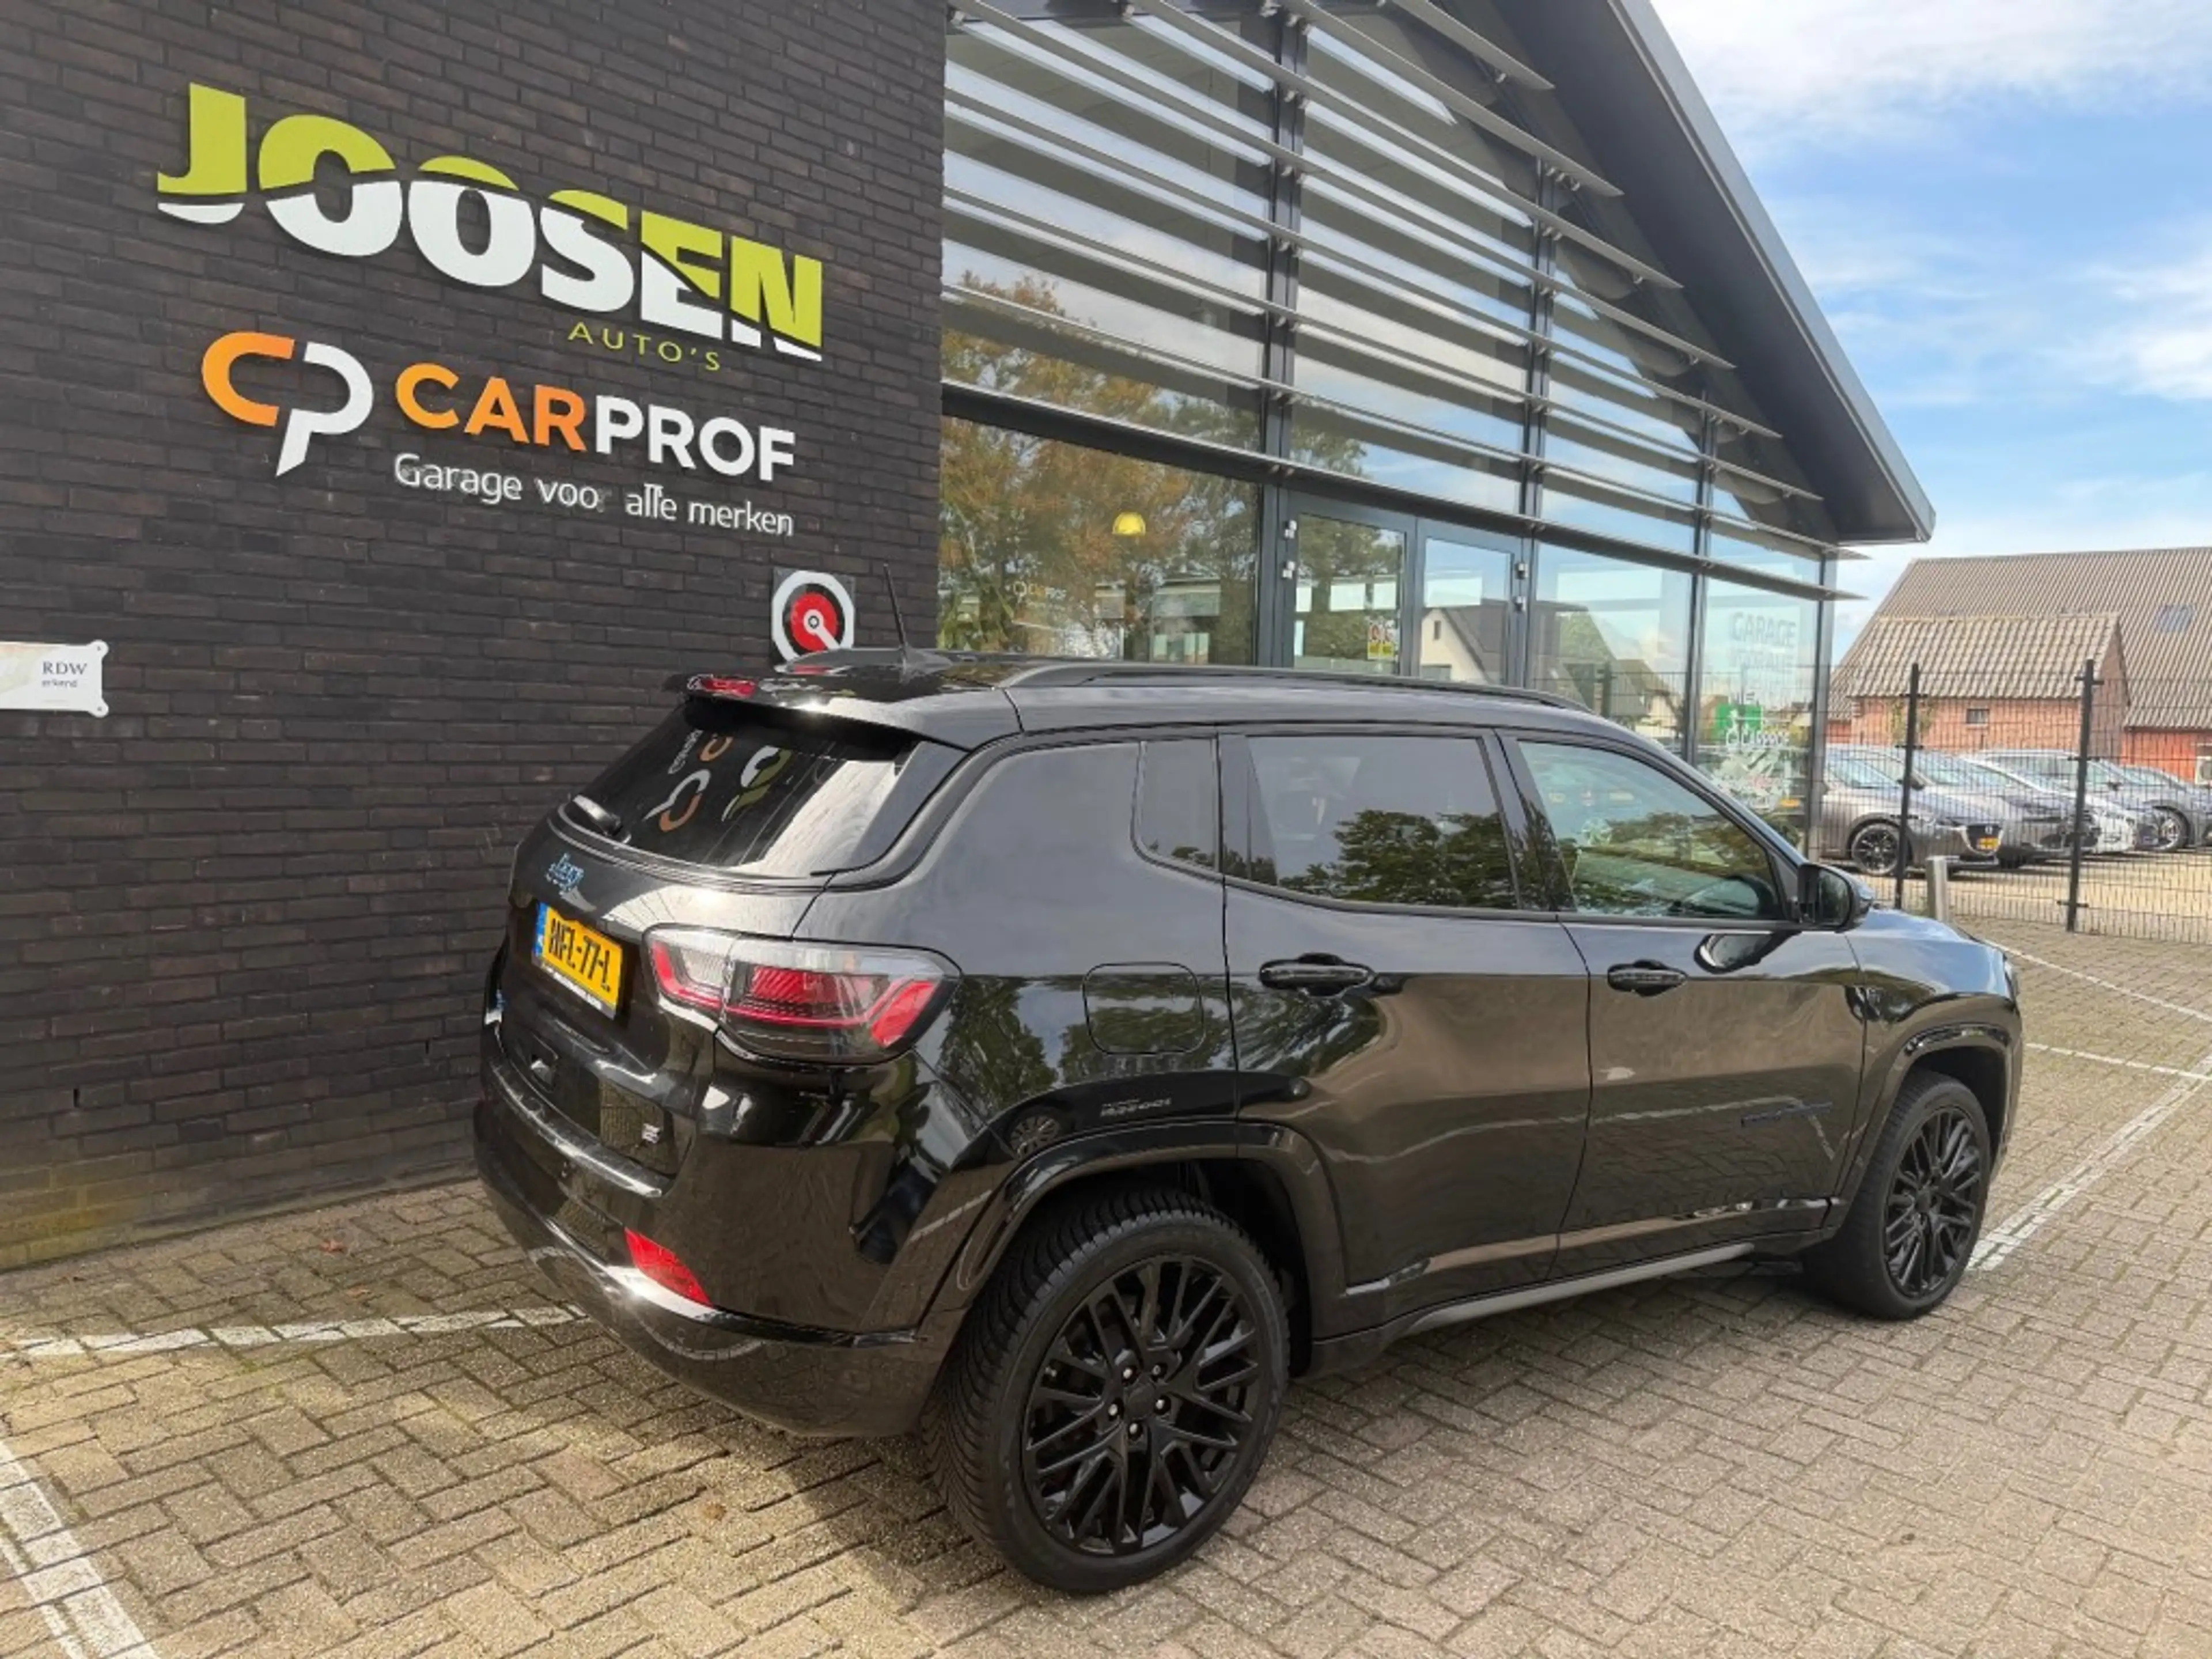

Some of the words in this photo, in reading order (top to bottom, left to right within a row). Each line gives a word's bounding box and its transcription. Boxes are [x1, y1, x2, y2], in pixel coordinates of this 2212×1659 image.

[158, 82, 823, 362] JOOSEN
[569, 321, 720, 372] AUTO'S
[395, 362, 796, 482] CARPROF
[393, 453, 522, 505] Garage
[624, 483, 677, 522] alle
[688, 497, 794, 538] merken
[42, 661, 88, 675] RDW
